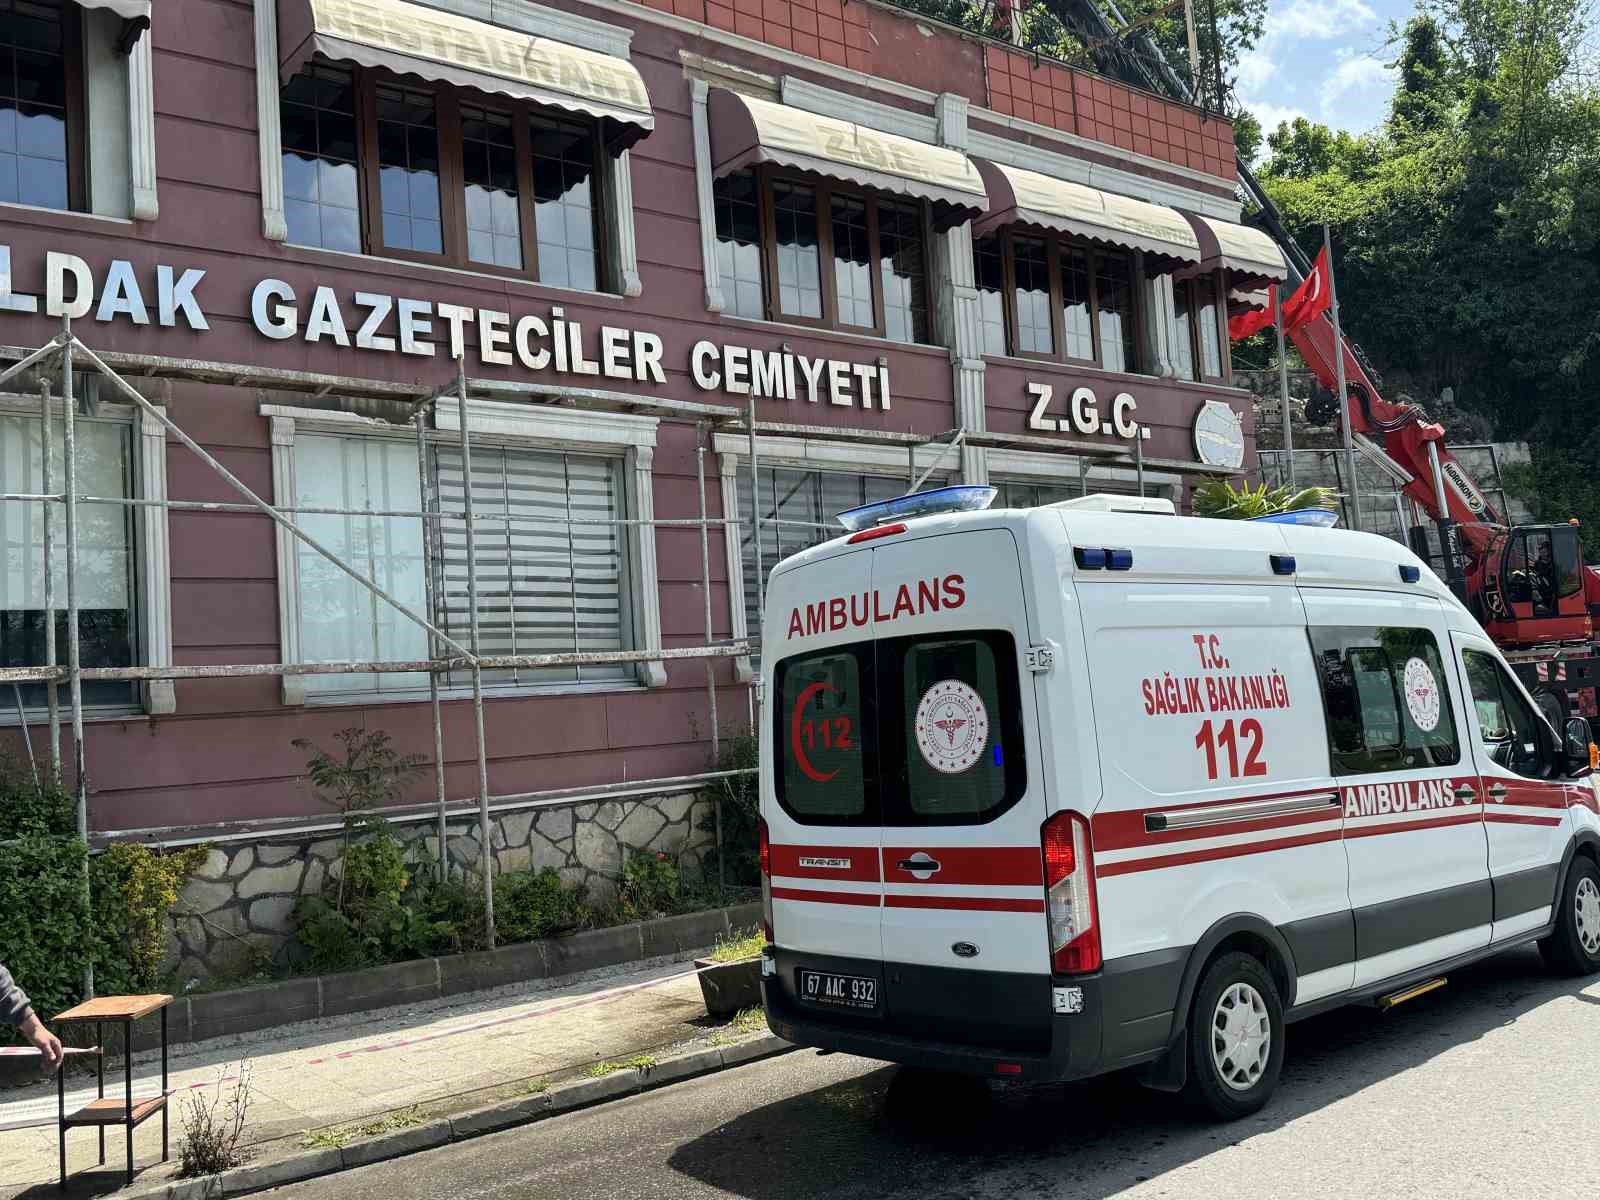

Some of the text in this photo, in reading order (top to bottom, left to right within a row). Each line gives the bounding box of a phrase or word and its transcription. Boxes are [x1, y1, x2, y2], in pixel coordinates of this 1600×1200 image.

[0, 245, 890, 410] LDAK GAZETECİLER CEMİYETİ
[1028, 382, 1151, 438] Z.G.C.
[787, 574, 966, 640] AMBULANS
[1192, 634, 1230, 669] T.C.
[1142, 667, 1291, 716] SAĞLIK BAKANLIĞI
[803, 715, 857, 749] 112
[1195, 718, 1267, 780] 112
[1345, 779, 1456, 818] AMBULANS
[808, 974, 821, 994] 67
[825, 976, 846, 997] AAC
[852, 979, 874, 1001] 932
